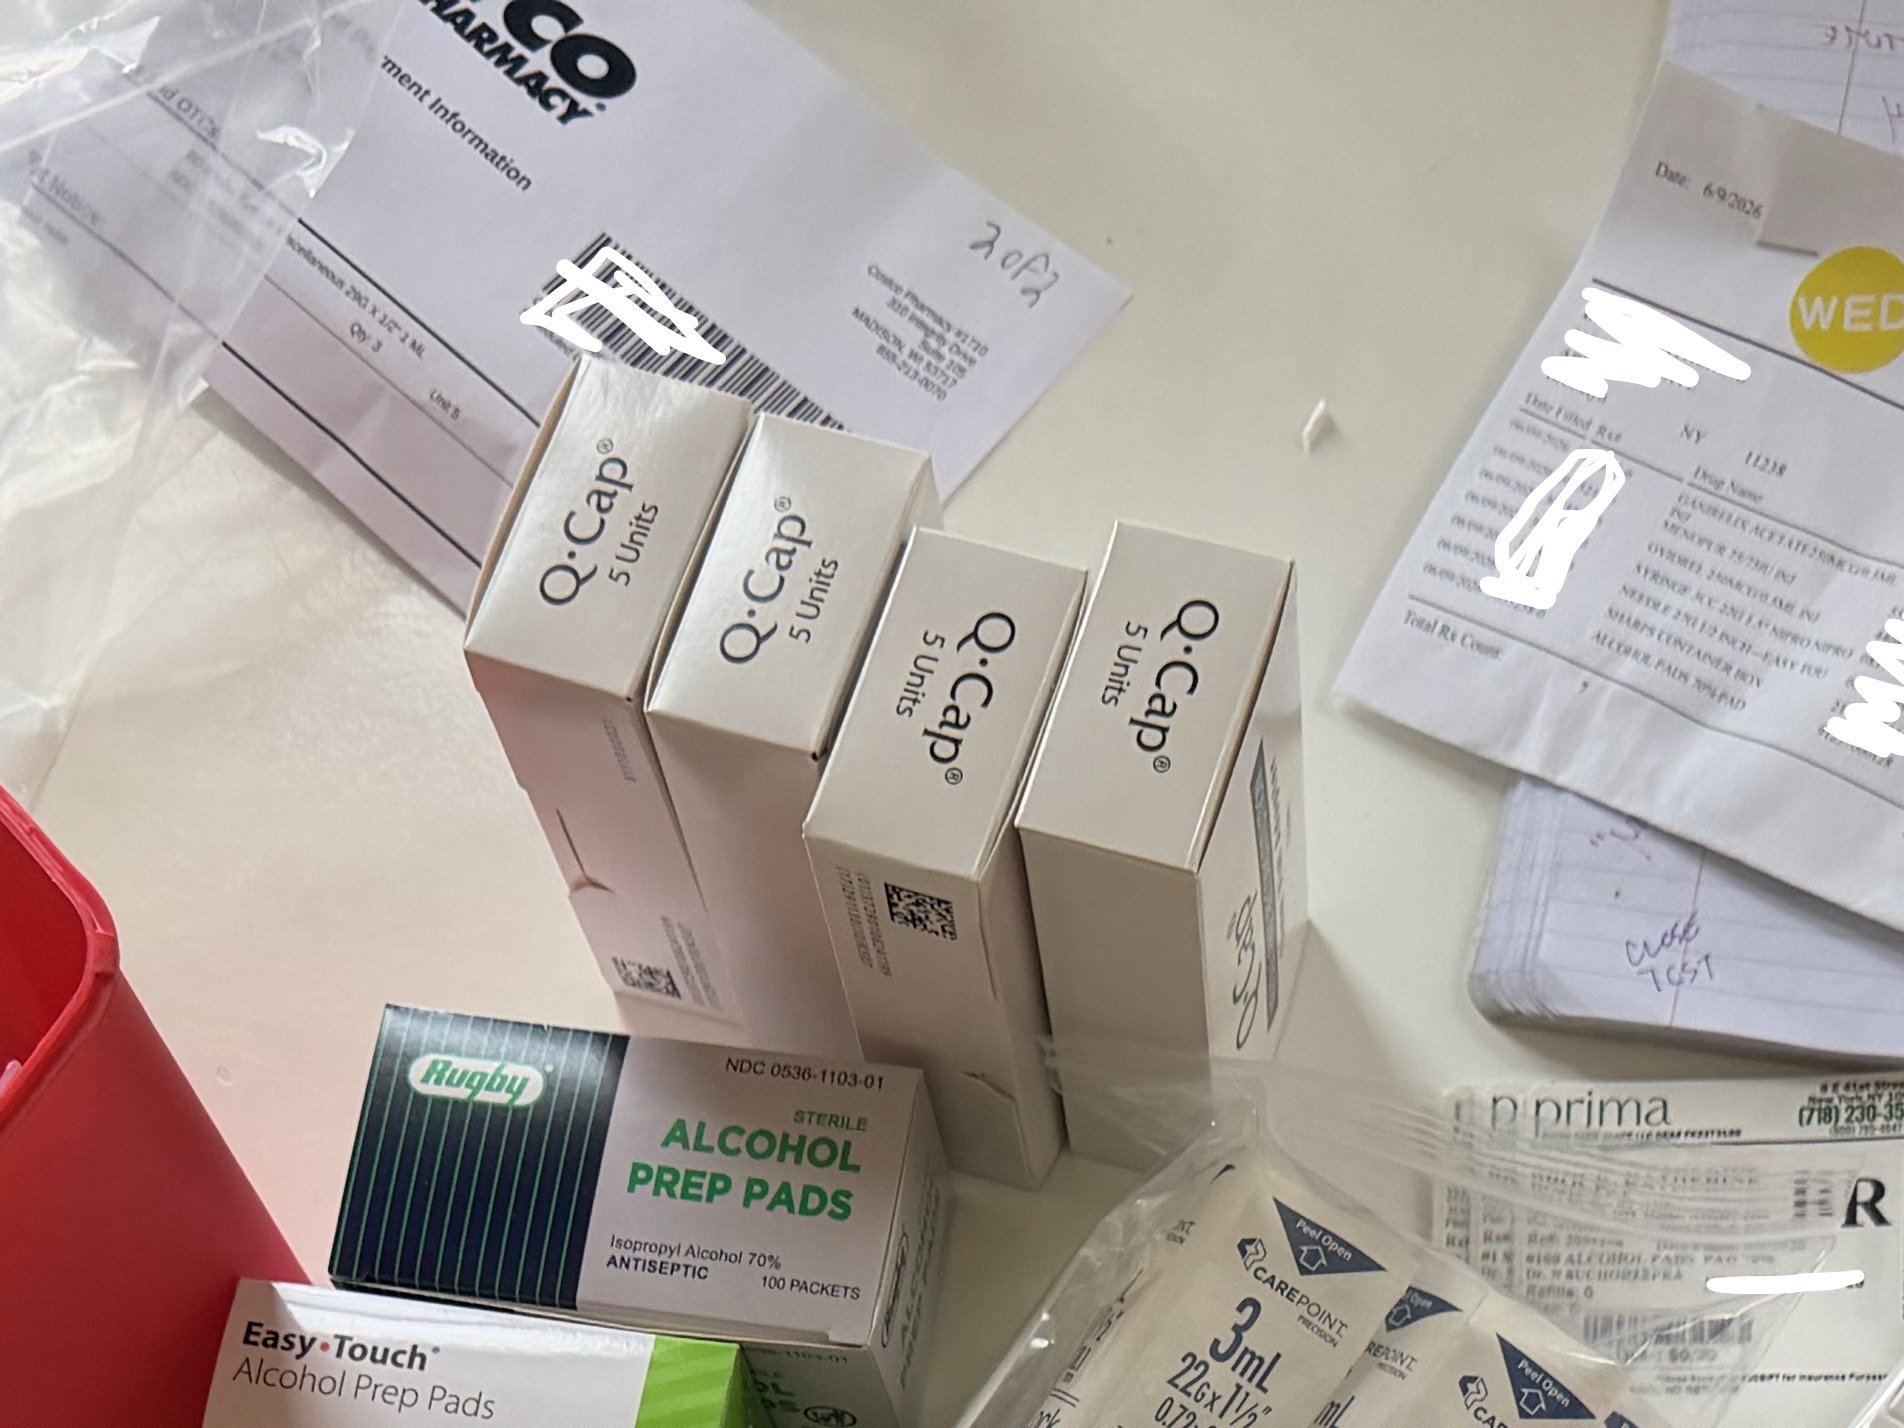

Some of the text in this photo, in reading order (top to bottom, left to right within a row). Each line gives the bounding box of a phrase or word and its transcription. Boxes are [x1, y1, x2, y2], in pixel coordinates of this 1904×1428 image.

[428, 97, 532, 191] Information
[609, 501, 658, 586] 5 Units
[789, 556, 838, 643] 5 Units
[896, 631, 945, 719] 5 Units
[1101, 621, 1148, 707] 5 Units
[420, 1058, 531, 1102] Rugby
[725, 1056, 884, 1091] NDC 0536-1103-01
[660, 1118, 861, 1173] ALCOHOL
[793, 1109, 868, 1132] STERILE
[626, 1161, 854, 1221] PREP PADS
[605, 1254, 709, 1280] ANTISEPTIC
[610, 1233, 782, 1270] Isopropyl Alcohol 70%
[762, 1275, 861, 1301] 100 PACKETS
[1254, 1266, 1348, 1338] CAREPOINT
[1209, 1297, 1282, 1394] 3mL
[232, 1357, 495, 1420] Alcohol Prep Pads
